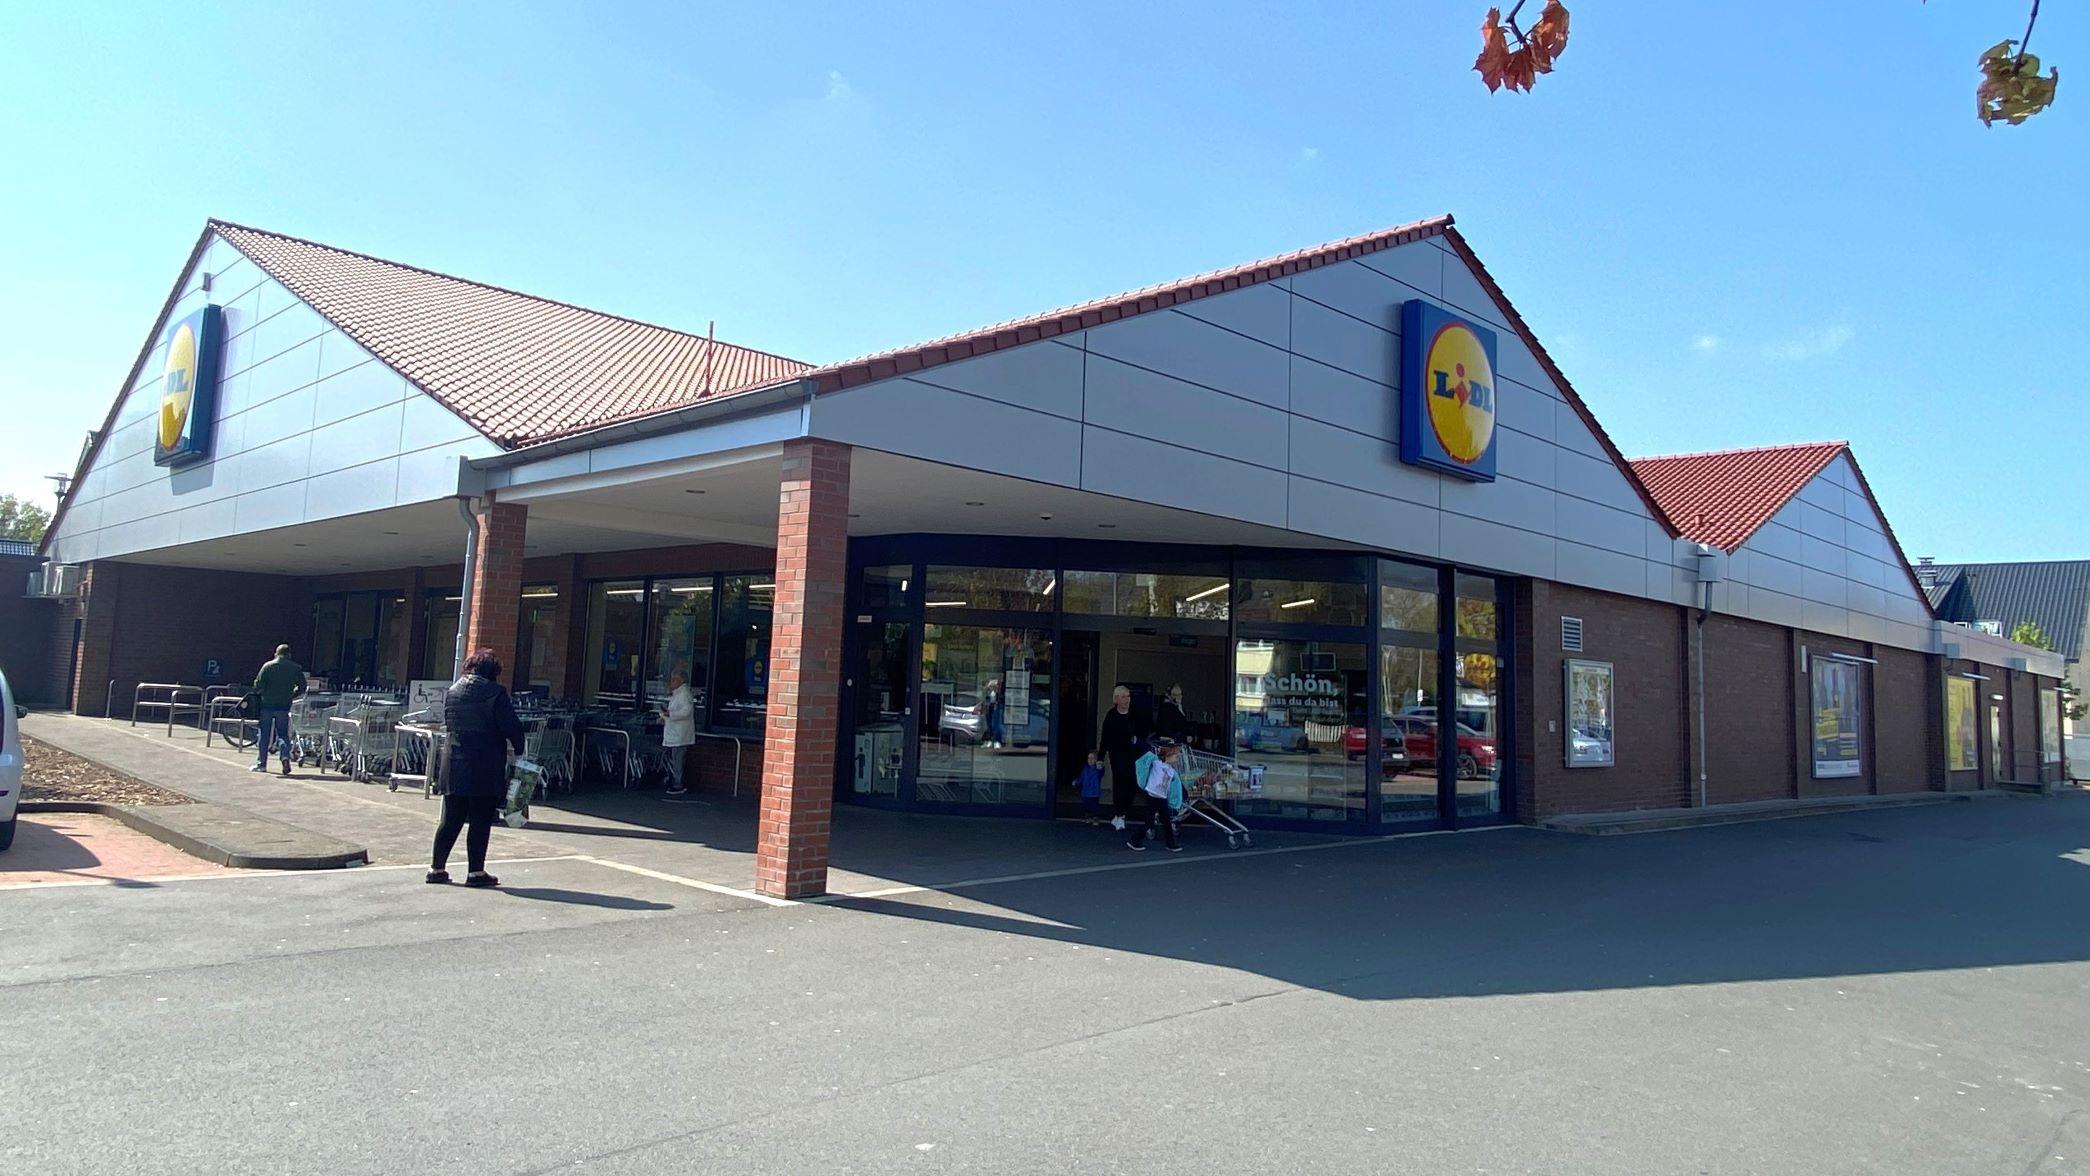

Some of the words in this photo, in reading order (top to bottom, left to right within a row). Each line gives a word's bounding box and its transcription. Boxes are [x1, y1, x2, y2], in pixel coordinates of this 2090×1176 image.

[1263, 672, 1339, 697] Schön,
[1288, 696, 1302, 706] du
[1304, 696, 1317, 707] da
